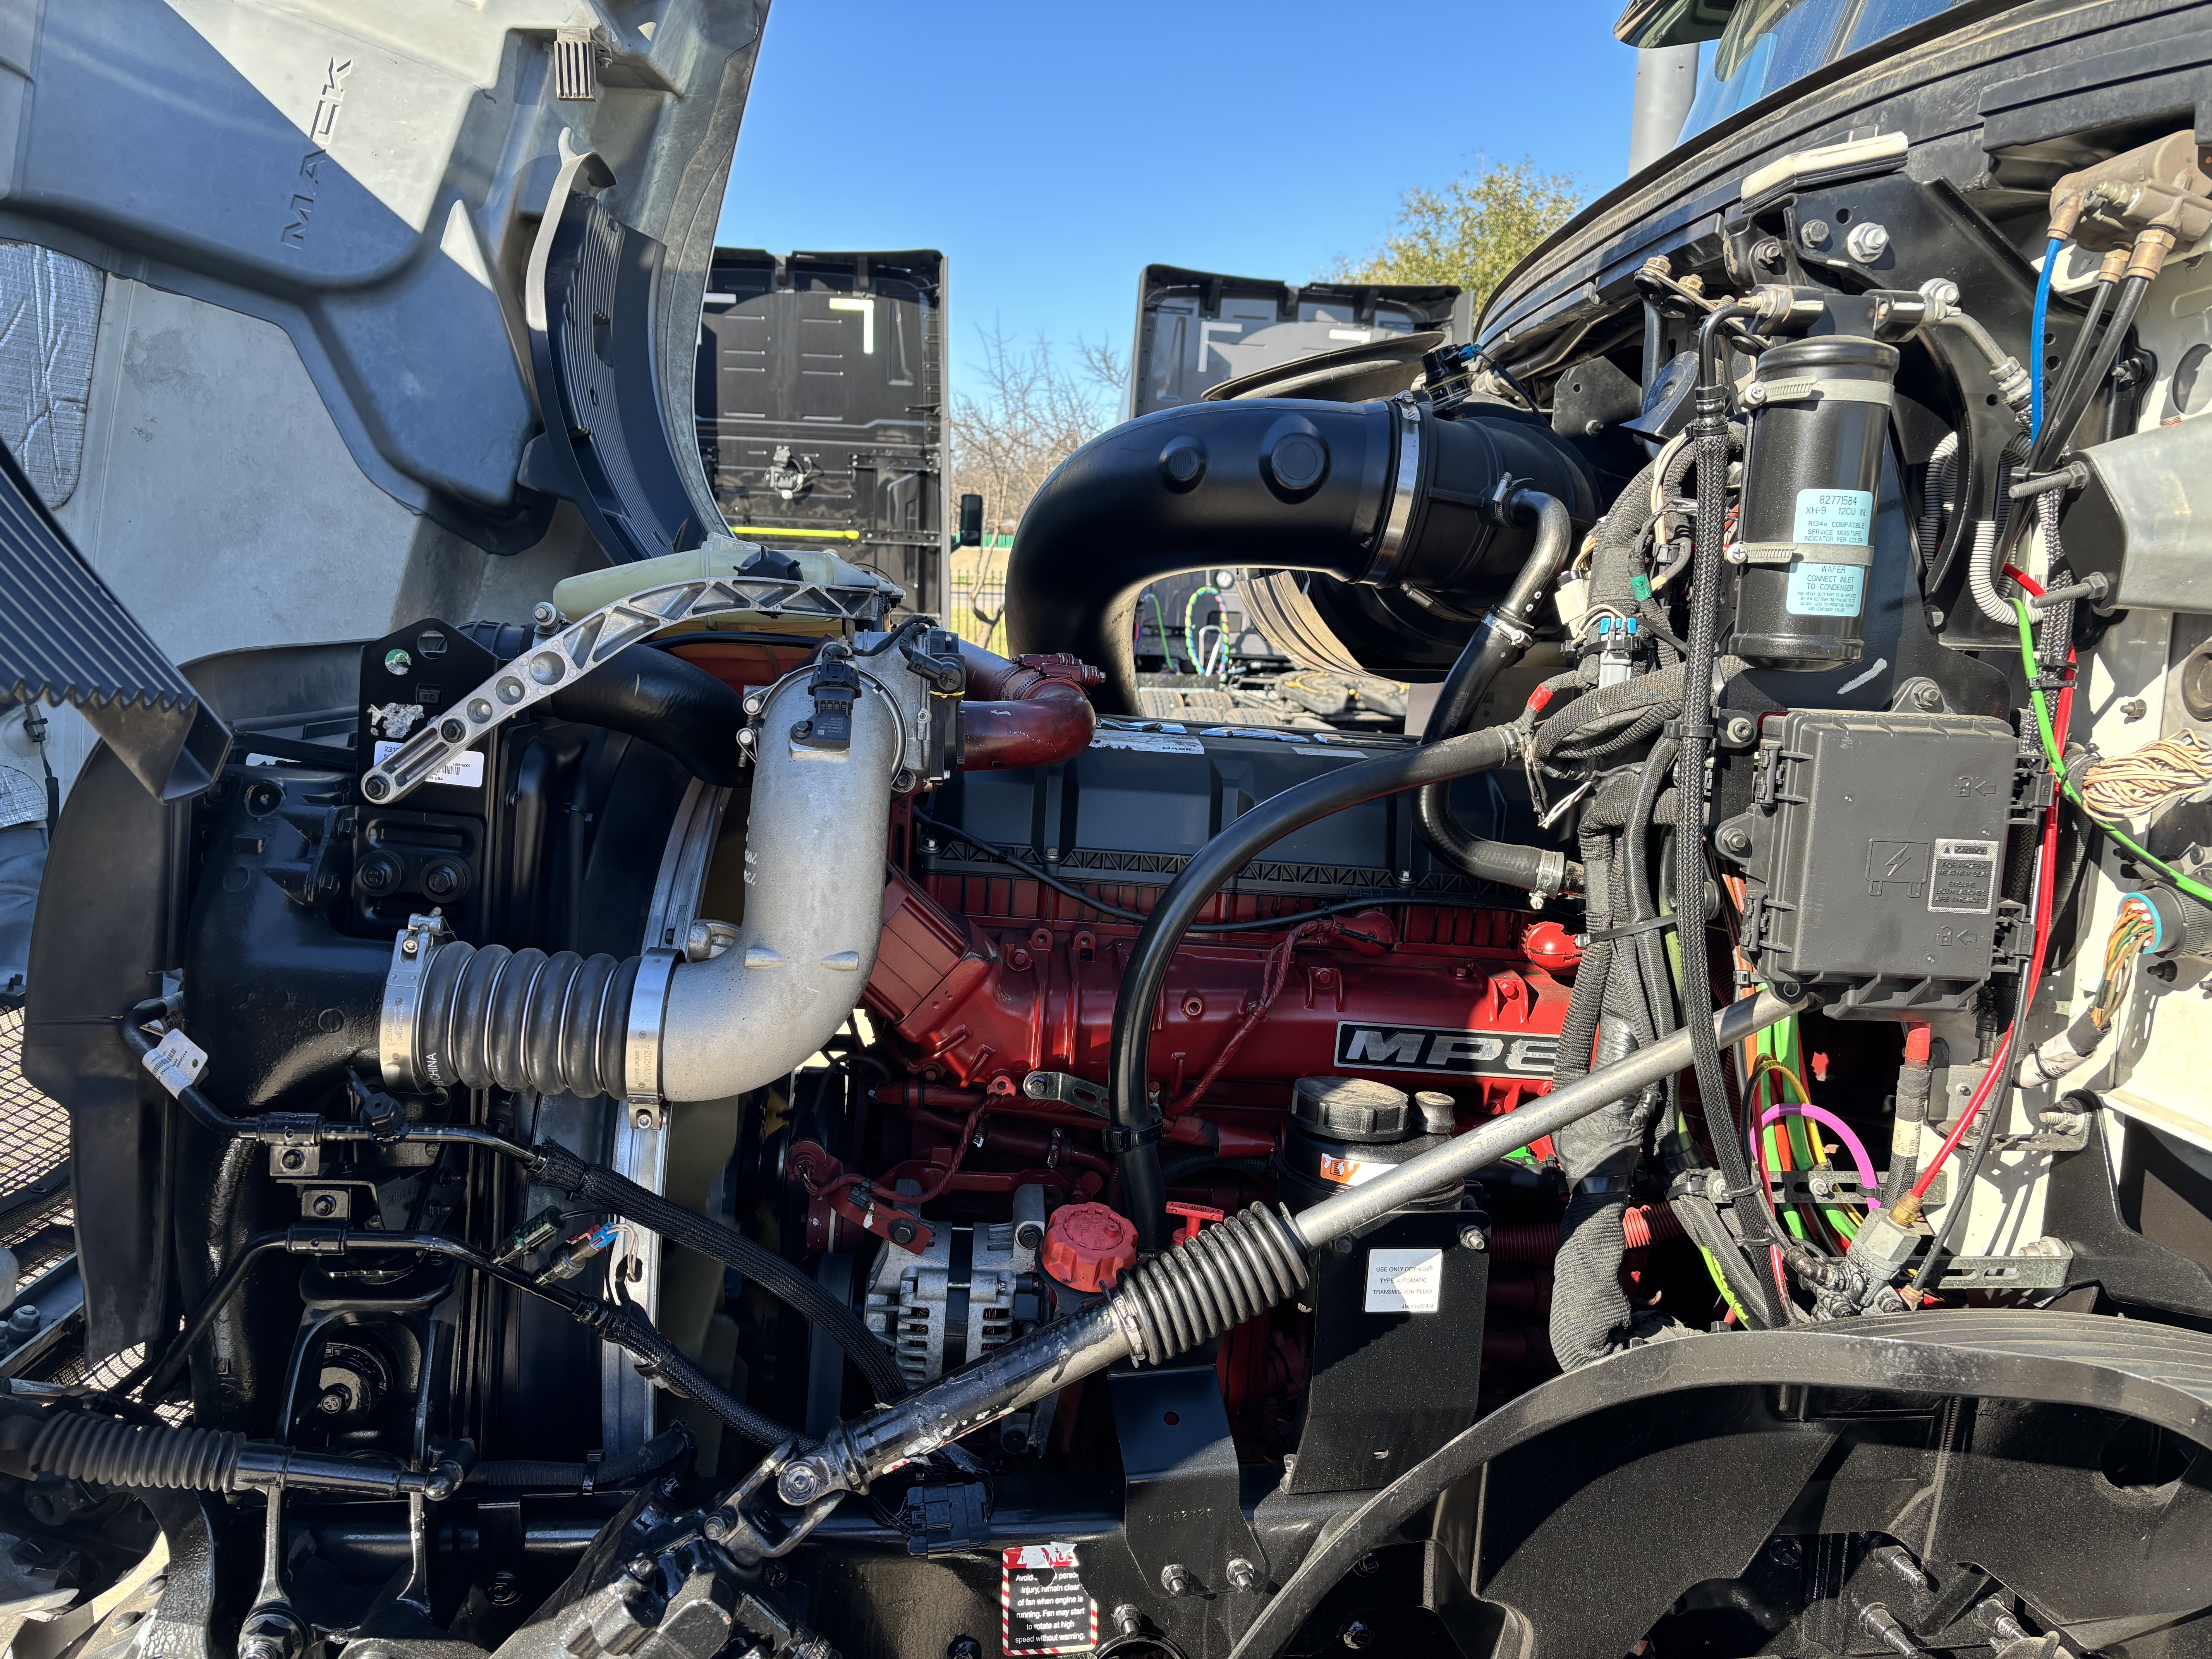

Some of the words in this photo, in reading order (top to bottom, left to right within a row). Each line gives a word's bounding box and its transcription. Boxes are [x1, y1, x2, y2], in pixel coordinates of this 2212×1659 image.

[280, 56, 353, 249] MACK
[426, 1052, 440, 1080] CHINA
[1055, 1596, 1076, 1606] engine
[1016, 1611, 1041, 1619] running.
[1061, 1620, 1075, 1630] high
[1015, 1635, 1034, 1645] speed
[1036, 1633, 1058, 1642] without
[1059, 1632, 1085, 1642] warning.
